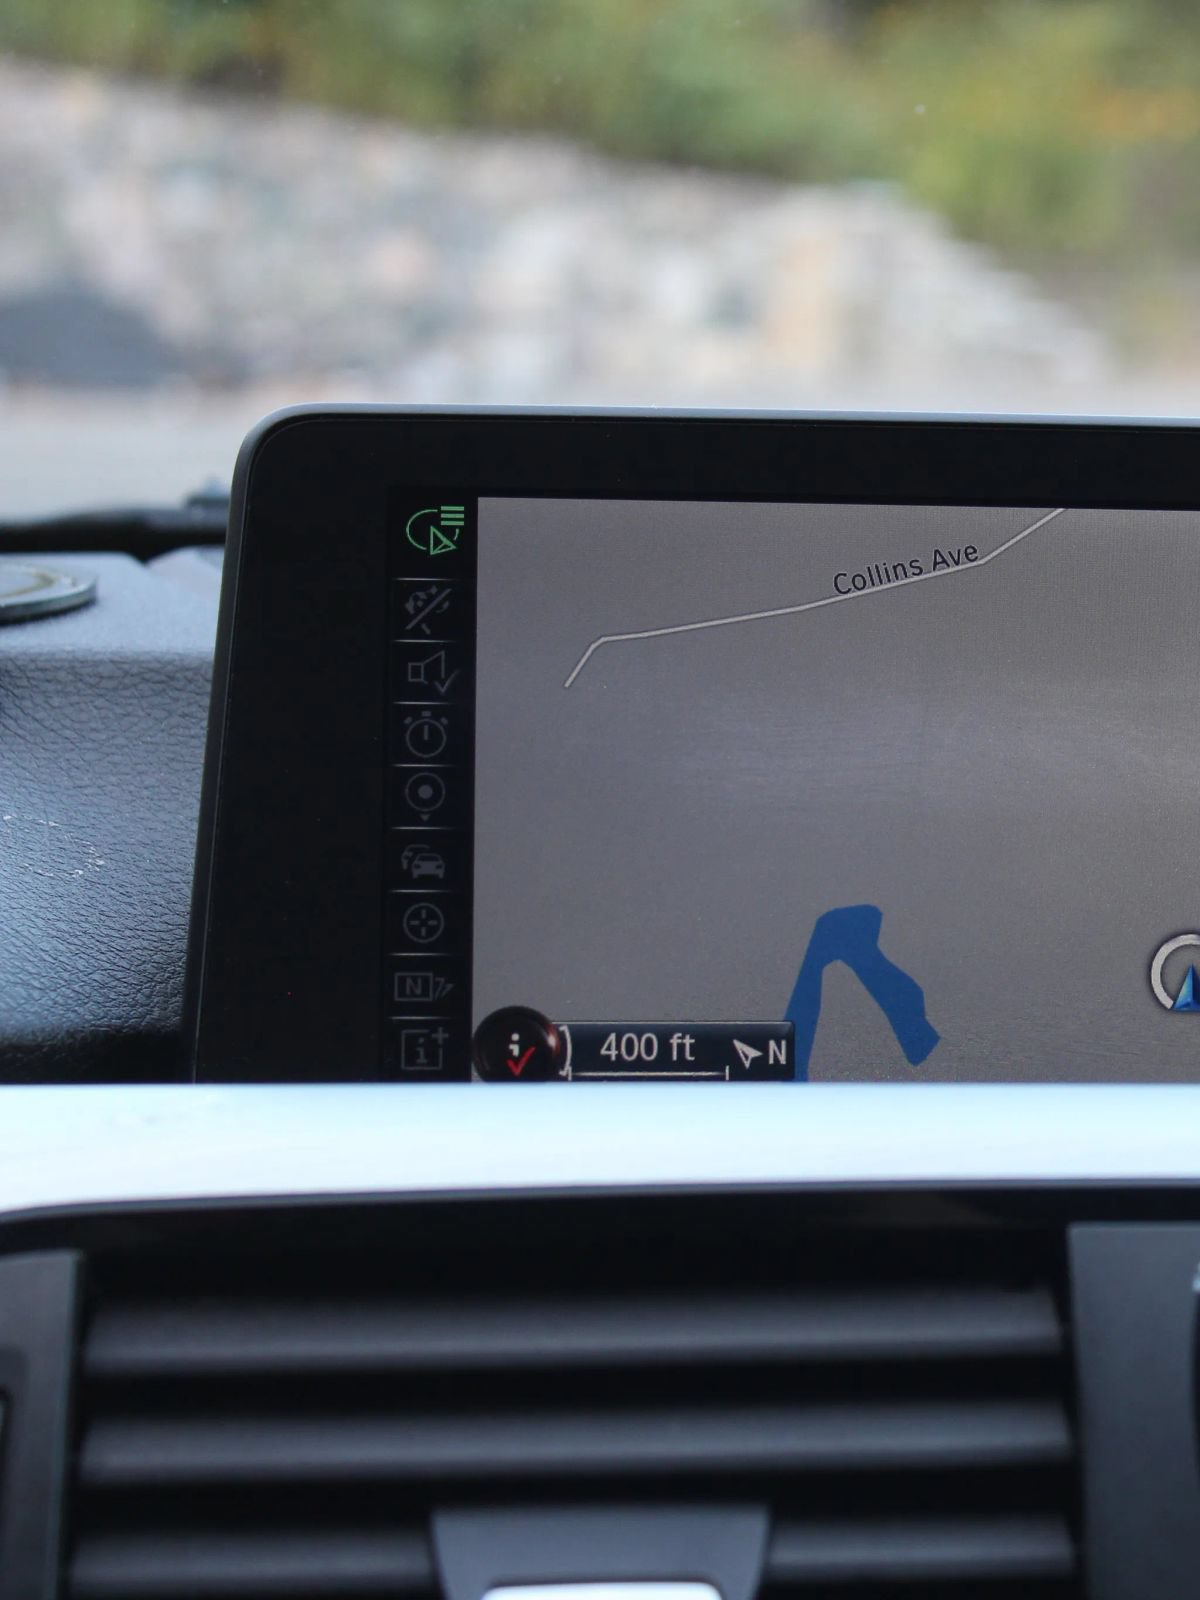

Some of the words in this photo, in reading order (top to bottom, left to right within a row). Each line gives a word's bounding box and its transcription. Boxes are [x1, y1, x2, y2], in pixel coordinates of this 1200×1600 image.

[833, 559, 923, 594] Collins
[932, 544, 979, 571] Ave
[600, 1032, 659, 1061] 400
[669, 1032, 695, 1061] ft
[768, 1039, 787, 1065] N
